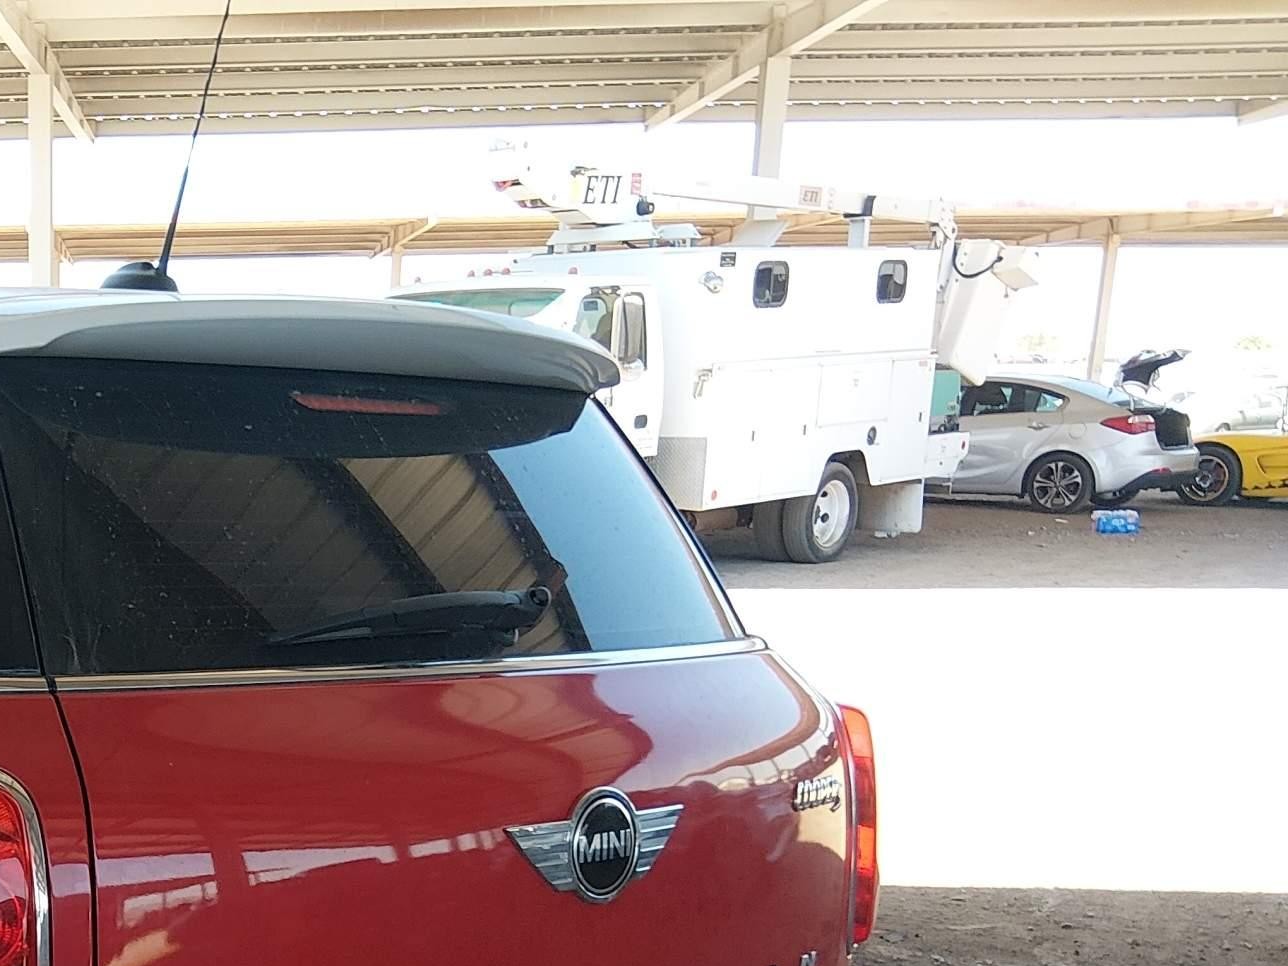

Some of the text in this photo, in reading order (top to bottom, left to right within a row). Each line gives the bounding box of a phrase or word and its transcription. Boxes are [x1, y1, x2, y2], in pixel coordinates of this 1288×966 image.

[581, 175, 623, 205] ETI
[802, 189, 819, 204] ETI
[578, 828, 632, 864] MINI
